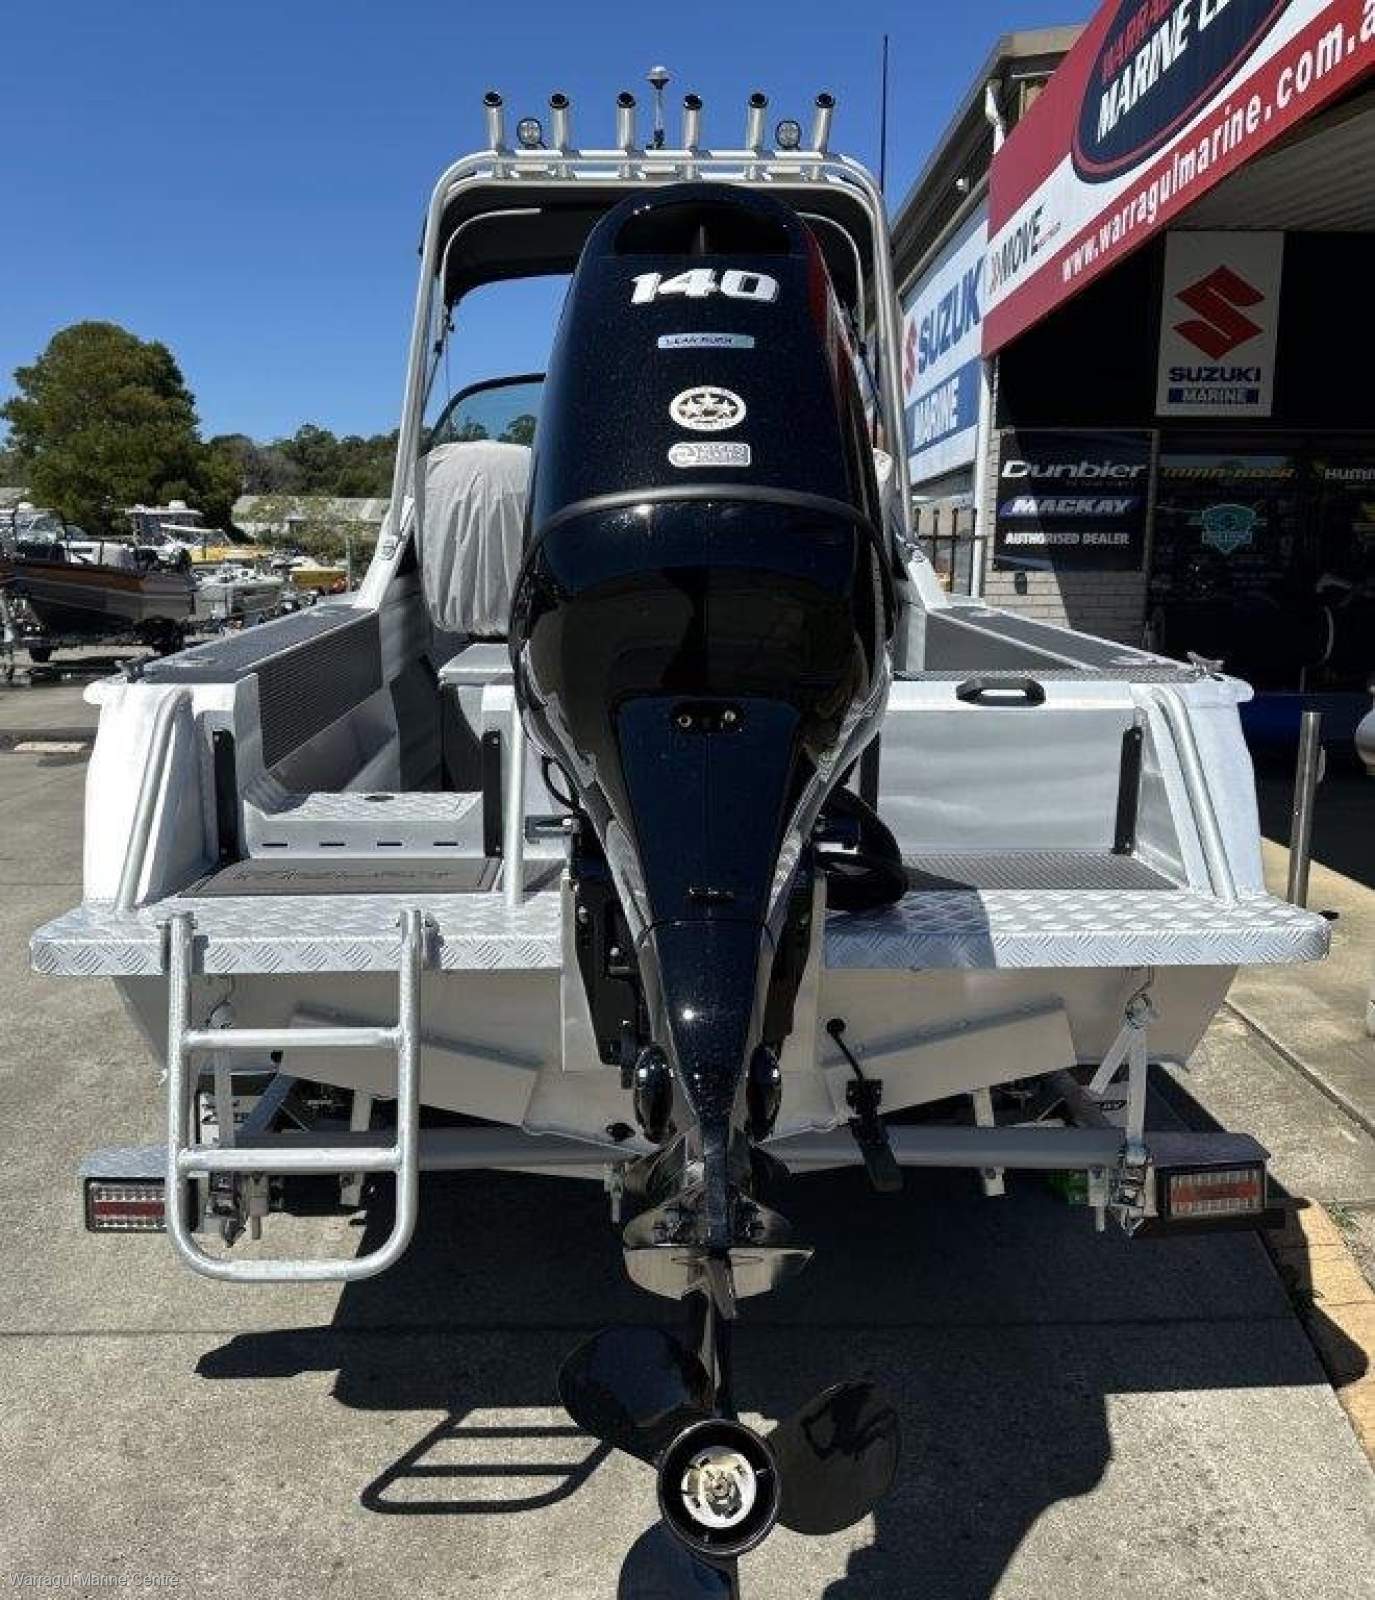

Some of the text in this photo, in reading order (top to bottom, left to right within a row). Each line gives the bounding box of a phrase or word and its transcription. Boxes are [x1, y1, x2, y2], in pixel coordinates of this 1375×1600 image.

[1098, 0, 1192, 143] MARINE
[630, 268, 779, 304] 140
[918, 254, 985, 374] SUZUK
[1169, 367, 1261, 382] SUZUKI
[1184, 388, 1248, 402] MARINE
[914, 376, 960, 449] MARINE
[1001, 459, 1147, 478] Dunbier
[1012, 497, 1132, 515] MACKAY
[1005, 532, 1131, 545] AUTHORISED DEALER
